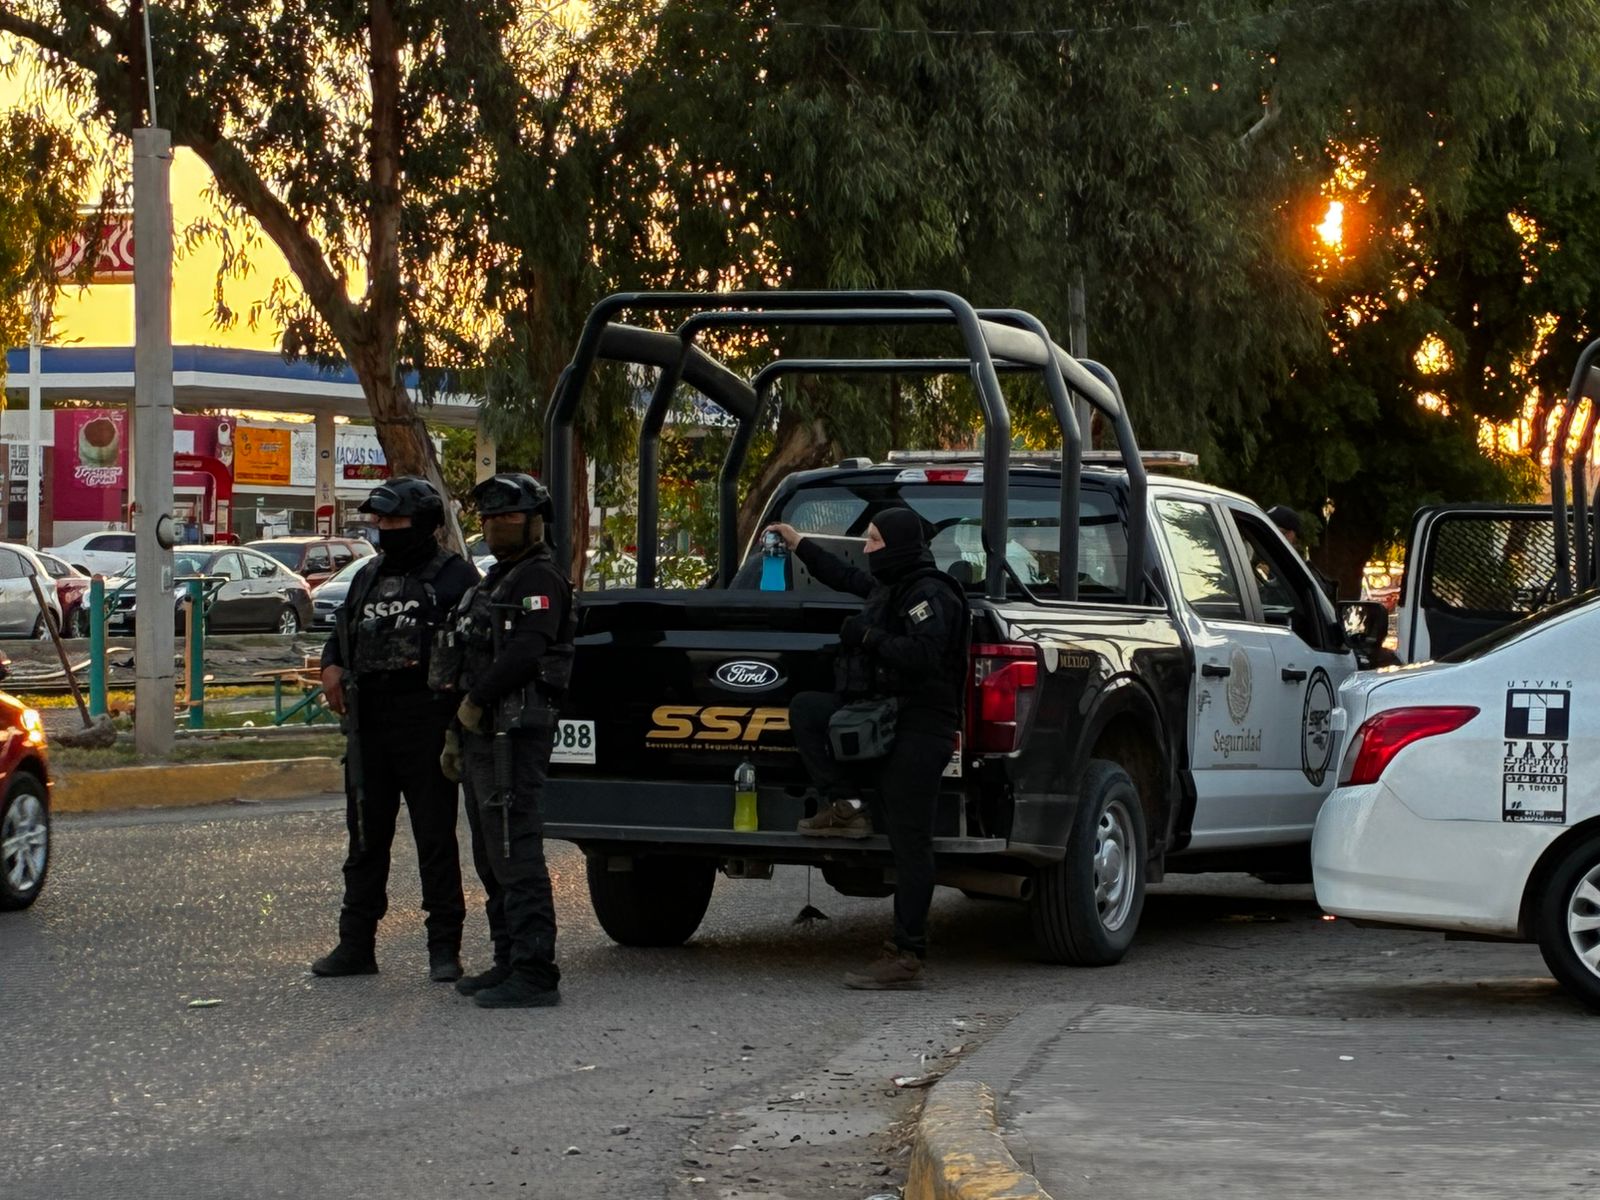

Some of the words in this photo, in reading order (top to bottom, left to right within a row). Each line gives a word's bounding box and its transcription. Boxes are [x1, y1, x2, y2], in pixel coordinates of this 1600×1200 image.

[727, 664, 767, 684] Ford
[1213, 728, 1262, 758] Seguridad
[1504, 741, 1568, 758] TAXI
